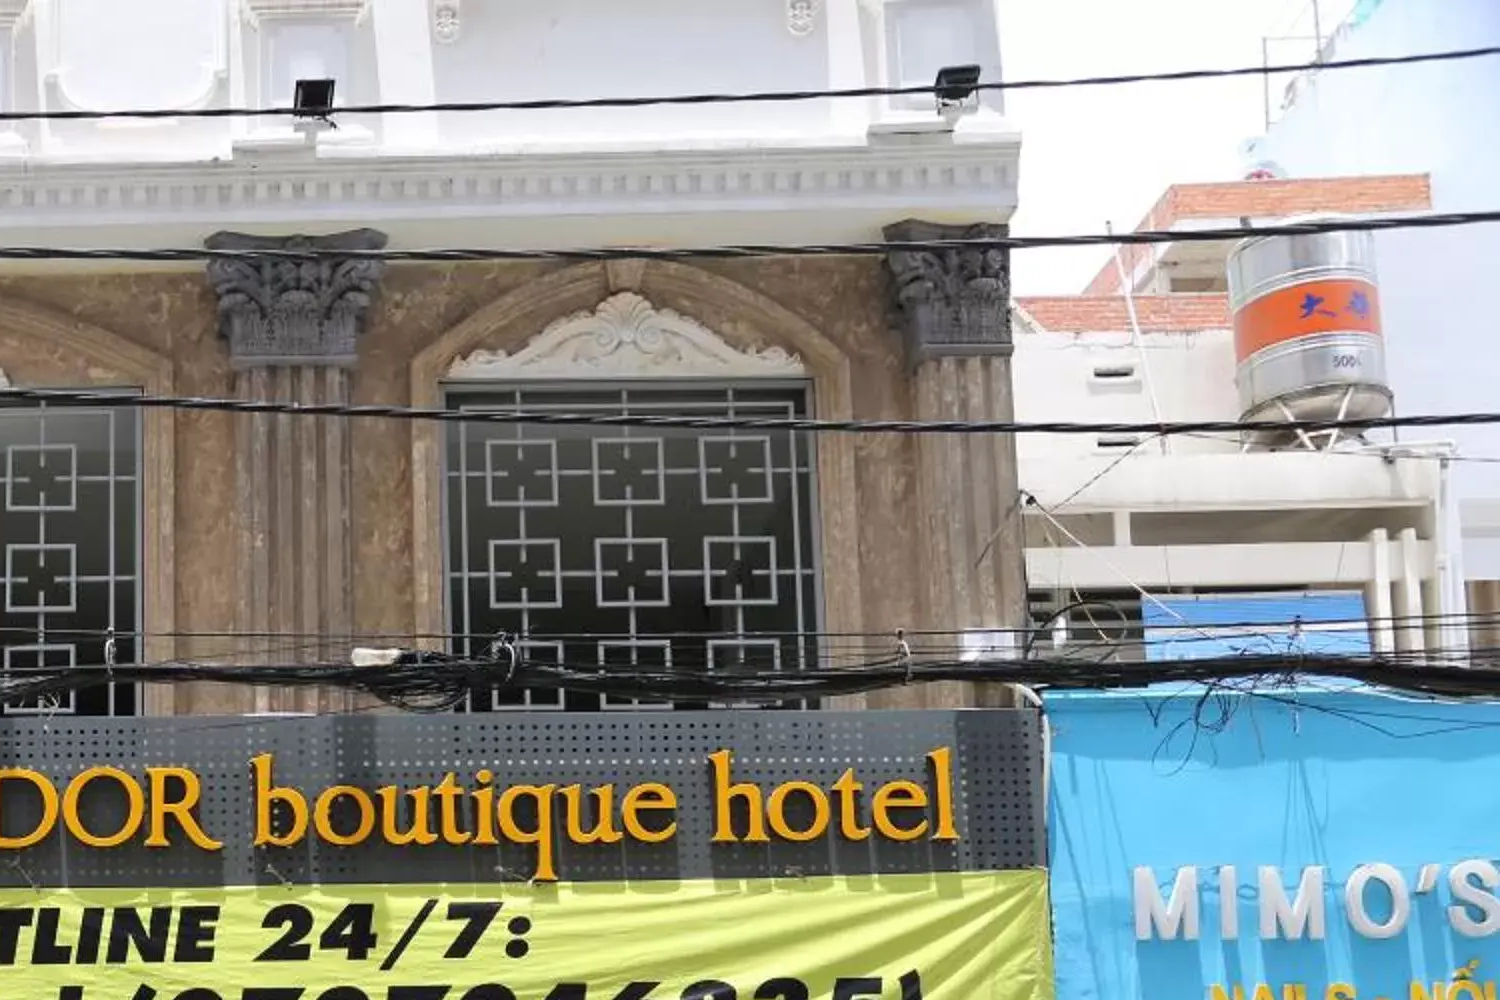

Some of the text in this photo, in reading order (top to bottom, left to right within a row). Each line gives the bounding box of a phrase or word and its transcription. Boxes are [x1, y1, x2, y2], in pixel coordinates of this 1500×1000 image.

[249, 753, 678, 882] boutique
[708, 747, 959, 843] hotel
[254, 897, 532, 971] 24/7:
[1132, 857, 1500, 940] MIMO'S
